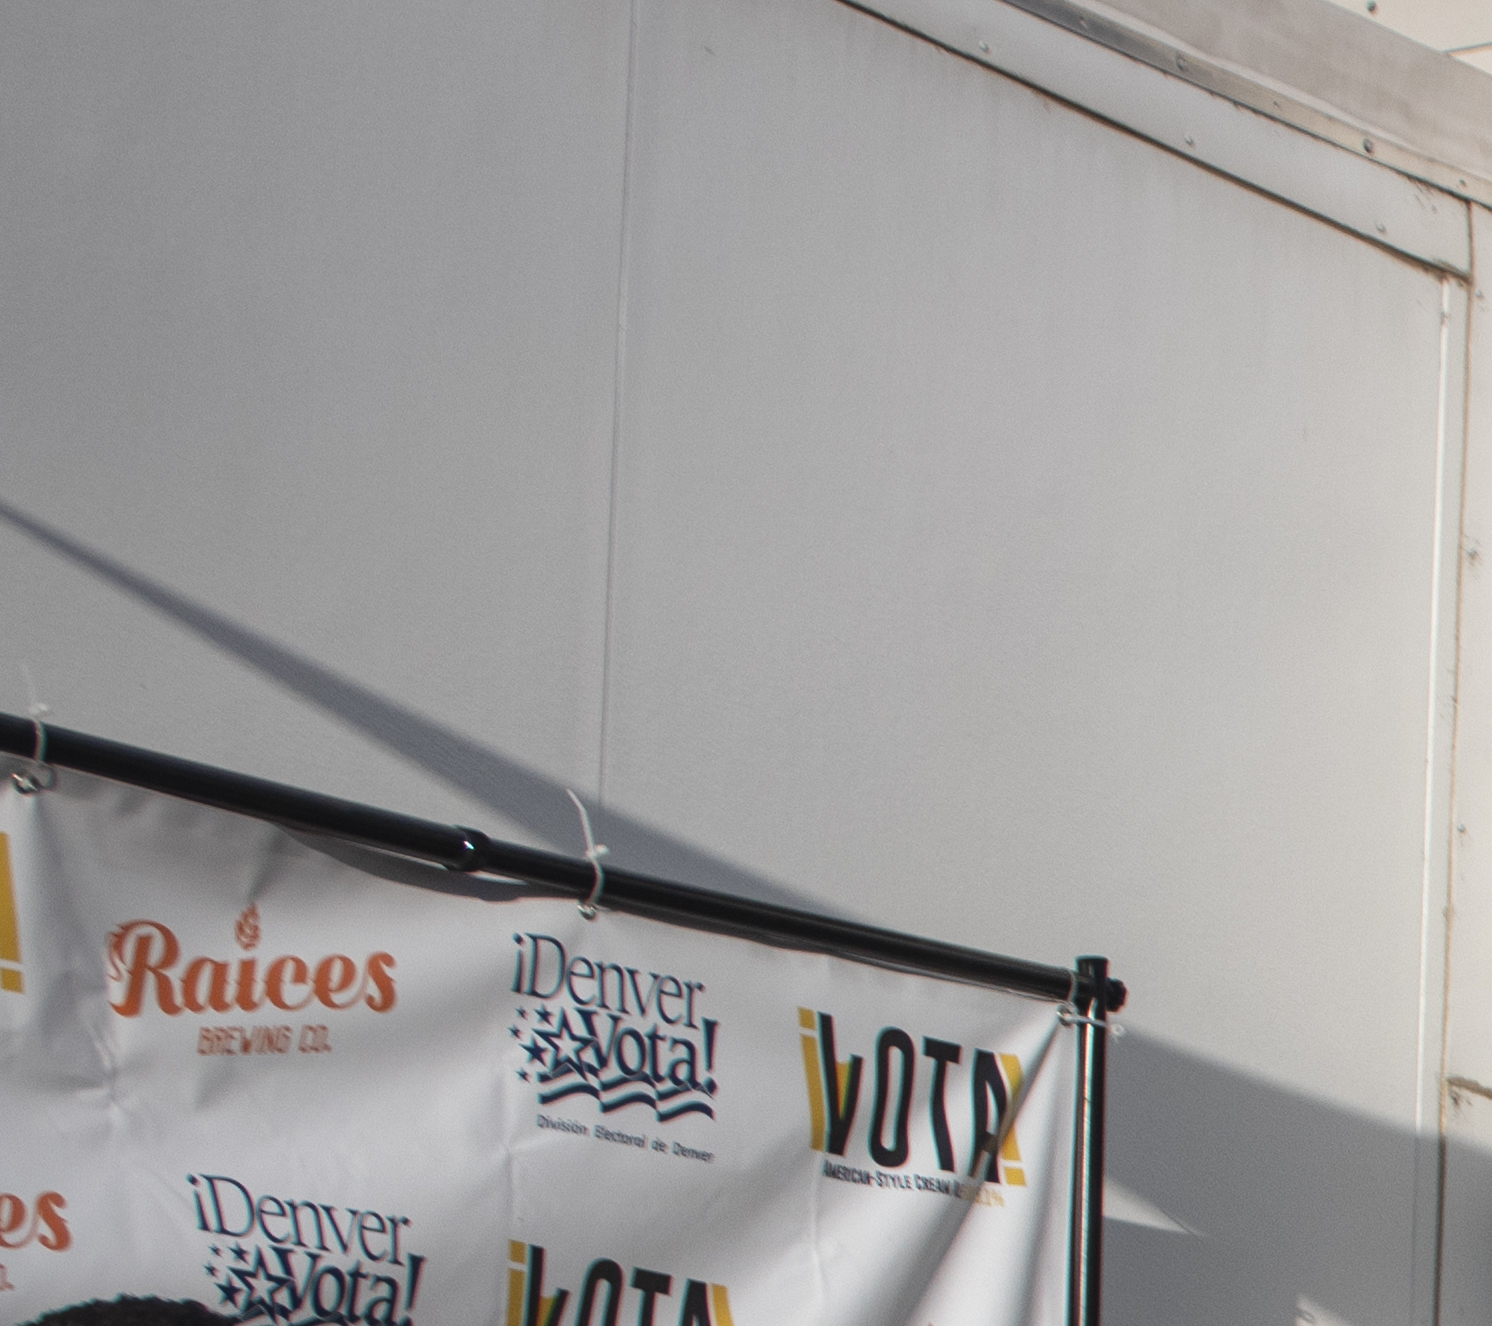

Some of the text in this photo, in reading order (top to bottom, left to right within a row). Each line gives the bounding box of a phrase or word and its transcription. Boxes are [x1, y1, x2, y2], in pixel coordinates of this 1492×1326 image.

[198, 1025, 292, 1055] BREWING
[573, 1006, 720, 1097] Vota!
[593, 1125, 645, 1148] Electoral
[651, 1137, 667, 1152] de
[672, 1142, 715, 1162] Denver
